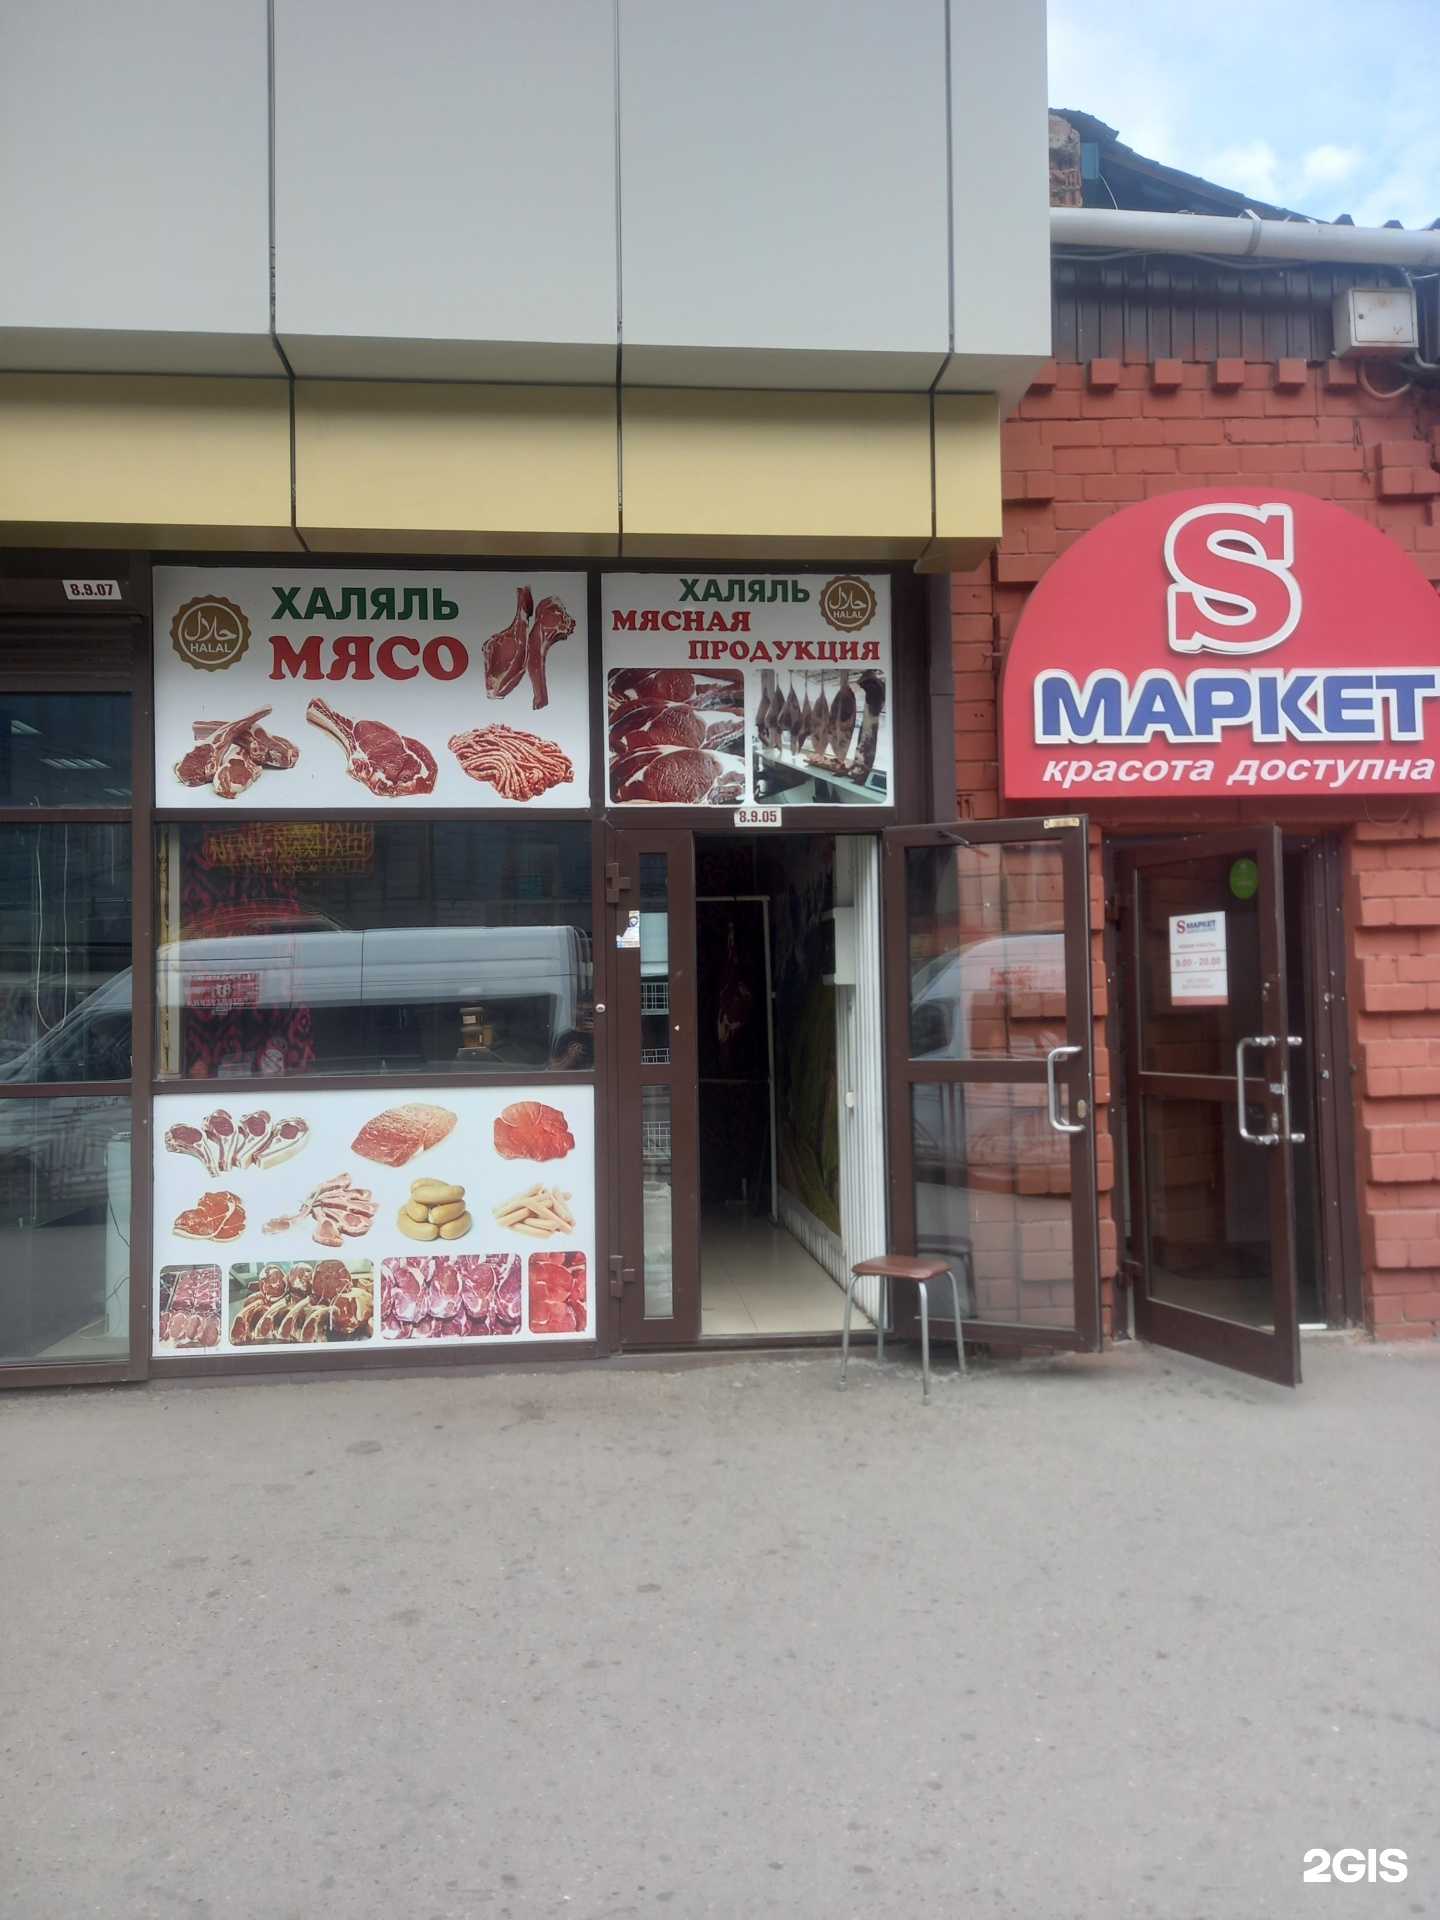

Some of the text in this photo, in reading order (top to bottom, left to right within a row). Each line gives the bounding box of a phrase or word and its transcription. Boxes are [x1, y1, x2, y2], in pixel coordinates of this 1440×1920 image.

[70, 583, 113, 596] 8.9.07
[678, 579, 810, 602] ХАЛЯЛЬ
[1164, 503, 1302, 655] S
[270, 586, 459, 620] ХАЛЯЛЬ
[833, 610, 864, 619] HALAL
[611, 609, 752, 632] МЯСНАЯ
[190, 642, 233, 653] HALAL
[268, 635, 469, 681] МЯСО
[687, 639, 881, 662] ПРОДУКЦИЯ
[1034, 667, 1440, 744] МАРКЕТ
[1042, 758, 1436, 789] красота доступна
[738, 810, 778, 824] 8.9.05
